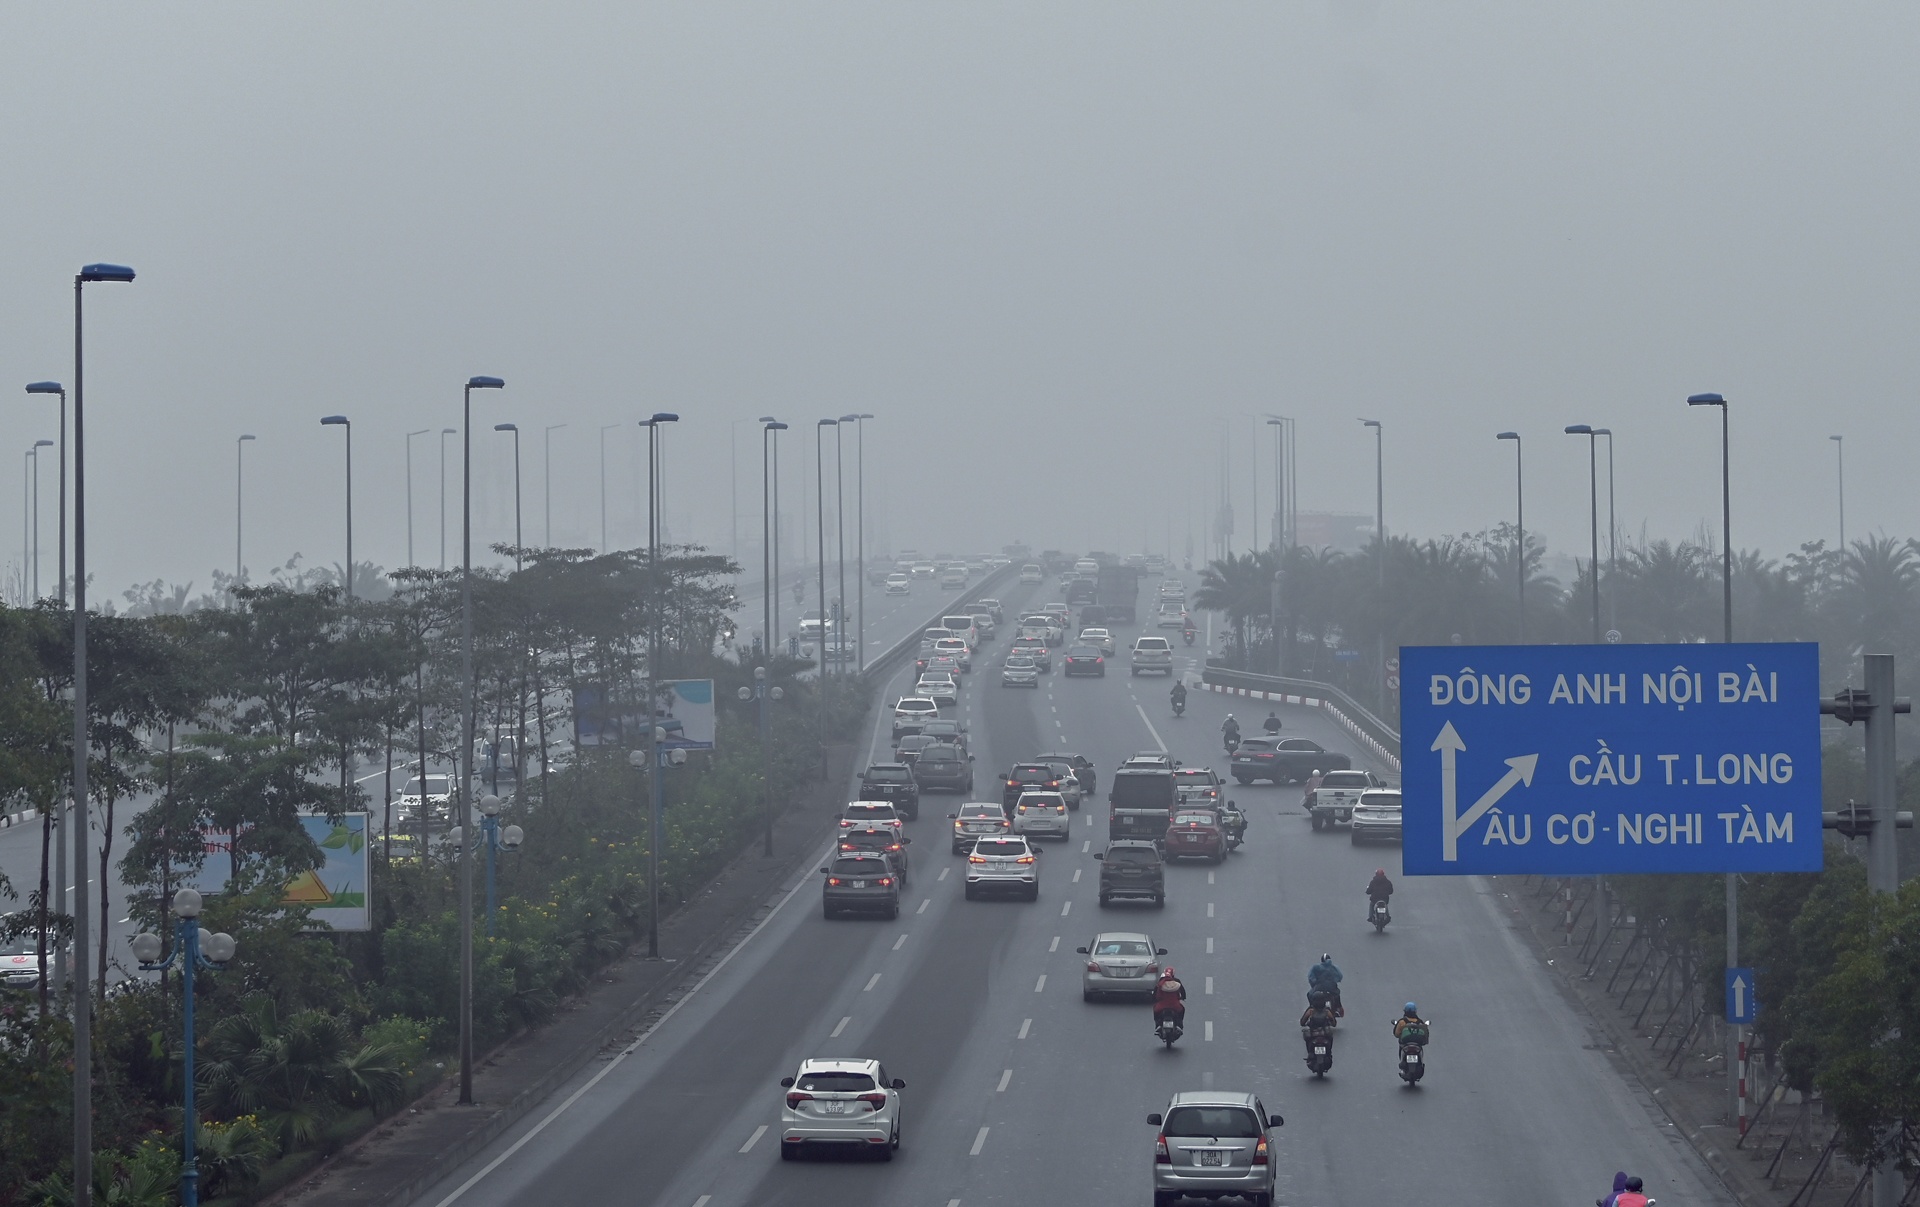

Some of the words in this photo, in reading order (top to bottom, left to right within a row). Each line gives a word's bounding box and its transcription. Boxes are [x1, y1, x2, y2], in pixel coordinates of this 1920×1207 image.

[1429, 666, 1531, 706] ĐÔNG
[1549, 673, 1626, 705] ANH
[1643, 664, 1702, 711] NỘI
[1719, 663, 1777, 704] BÀI
[1570, 738, 1641, 786] CẦU
[1658, 753, 1793, 786] T.LONG
[1482, 807, 1532, 845] ÂU
[1717, 804, 1793, 844] TÀM
